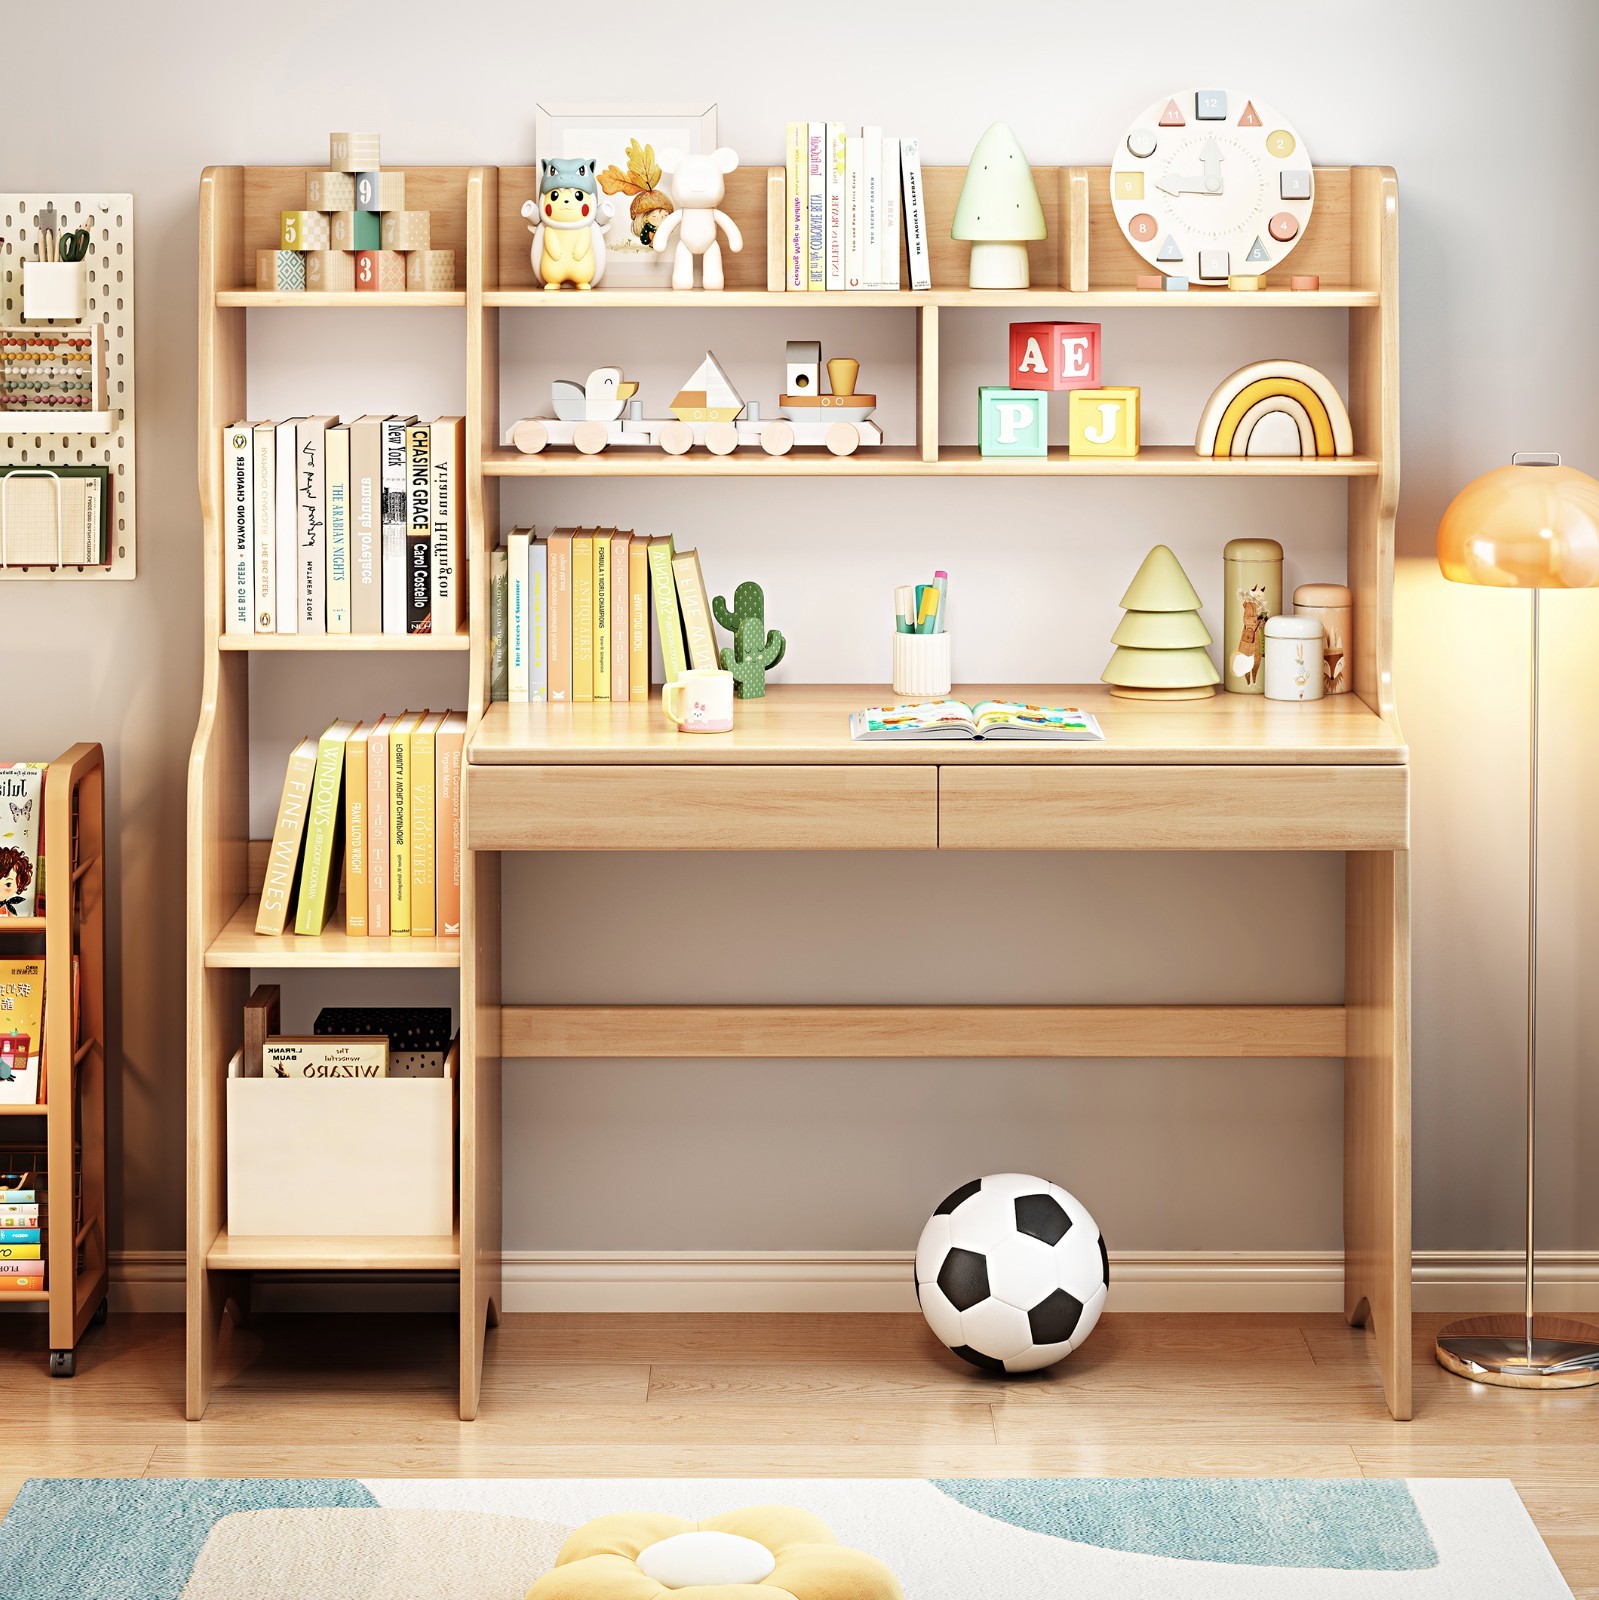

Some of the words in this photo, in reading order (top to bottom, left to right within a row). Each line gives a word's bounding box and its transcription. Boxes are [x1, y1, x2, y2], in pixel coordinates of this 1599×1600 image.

[1167, 110, 1180, 119] 11
[1204, 98, 1217, 108] 12
[1246, 114, 1253, 124] 1
[332, 141, 348, 159] 10
[1276, 139, 1284, 149] 2
[309, 180, 320, 202] 8
[359, 179, 372, 204] 9
[1124, 181, 1132, 192] 9
[1292, 179, 1299, 189] 3
[285, 217, 296, 243] 5
[335, 218, 345, 241] 6
[385, 218, 396, 243] 7
[1139, 224, 1147, 234] 8
[1280, 221, 1288, 231] 4
[1167, 245, 1174, 255] 7
[1253, 249, 1261, 259] 5
[260, 257, 267, 281] 1
[310, 257, 320, 282] 2
[359, 257, 372, 282] 3
[410, 257, 421, 281] 4
[1018, 337, 1048, 374] A
[1061, 336, 1090, 378] E
[388, 424, 405, 444] New
[995, 404, 1034, 444] P
[1083, 403, 1121, 444] J
[388, 447, 406, 467] York
[412, 430, 428, 486] CHASING
[332, 483, 344, 501] THE
[412, 489, 428, 530] GRACE
[332, 504, 344, 544] ARABIAN
[332, 546, 345, 581] NIGHTS
[413, 543, 427, 568] Carol
[413, 570, 428, 608] Costello
[579, 579, 592, 661] ANTIQUAIRES
[441, 752, 450, 774] Virginia
[314, 746, 339, 827] WINDOWS
[441, 775, 450, 798] McLeod
[452, 776, 460, 817] Contemporary
[281, 780, 306, 831] FINE
[351, 802, 361, 824] FRANK
[351, 825, 361, 847] LLOYD
[312, 834, 324, 866] BERGDORF
[351, 847, 362, 874] WRIGHT
[265, 839, 294, 912] WINES
[308, 867, 319, 899] GOODMAN
